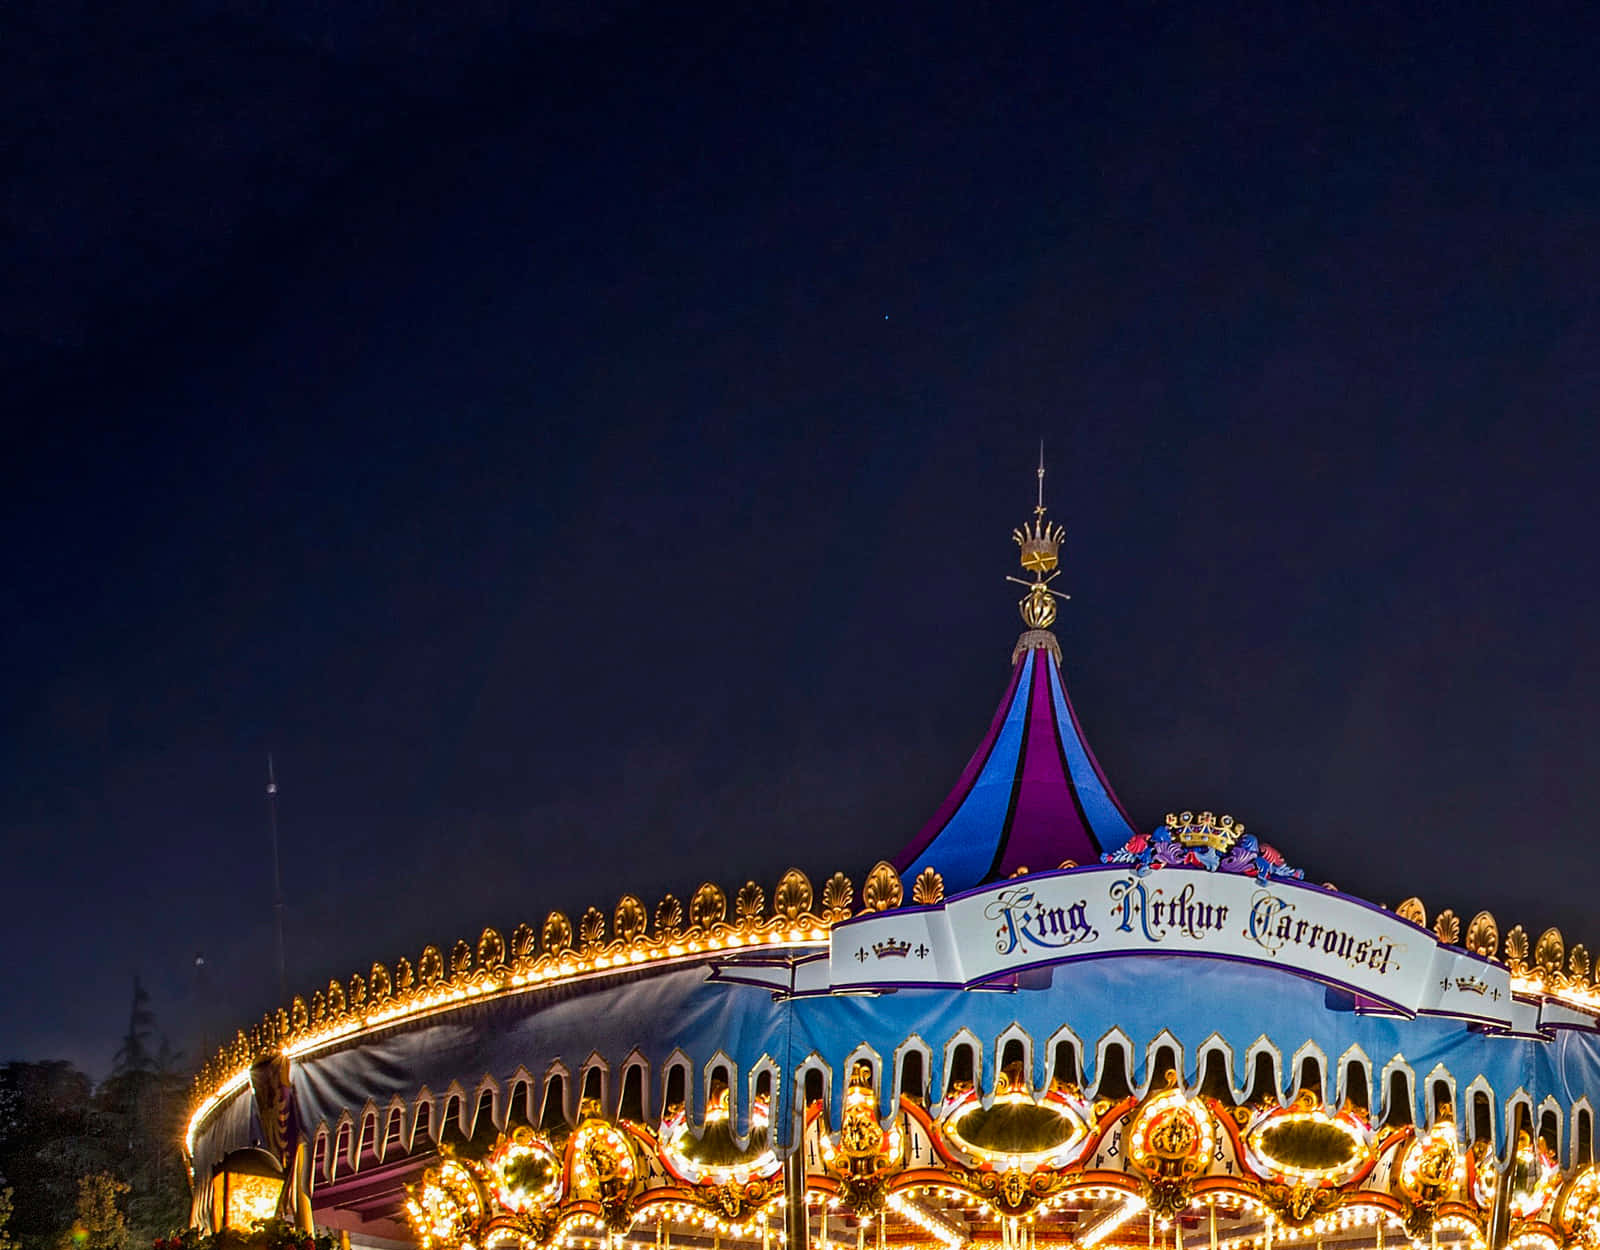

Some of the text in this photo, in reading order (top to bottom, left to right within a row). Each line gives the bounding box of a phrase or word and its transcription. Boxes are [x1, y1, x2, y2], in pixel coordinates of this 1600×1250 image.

[984, 877, 1400, 974] King Arthur Carrousel
